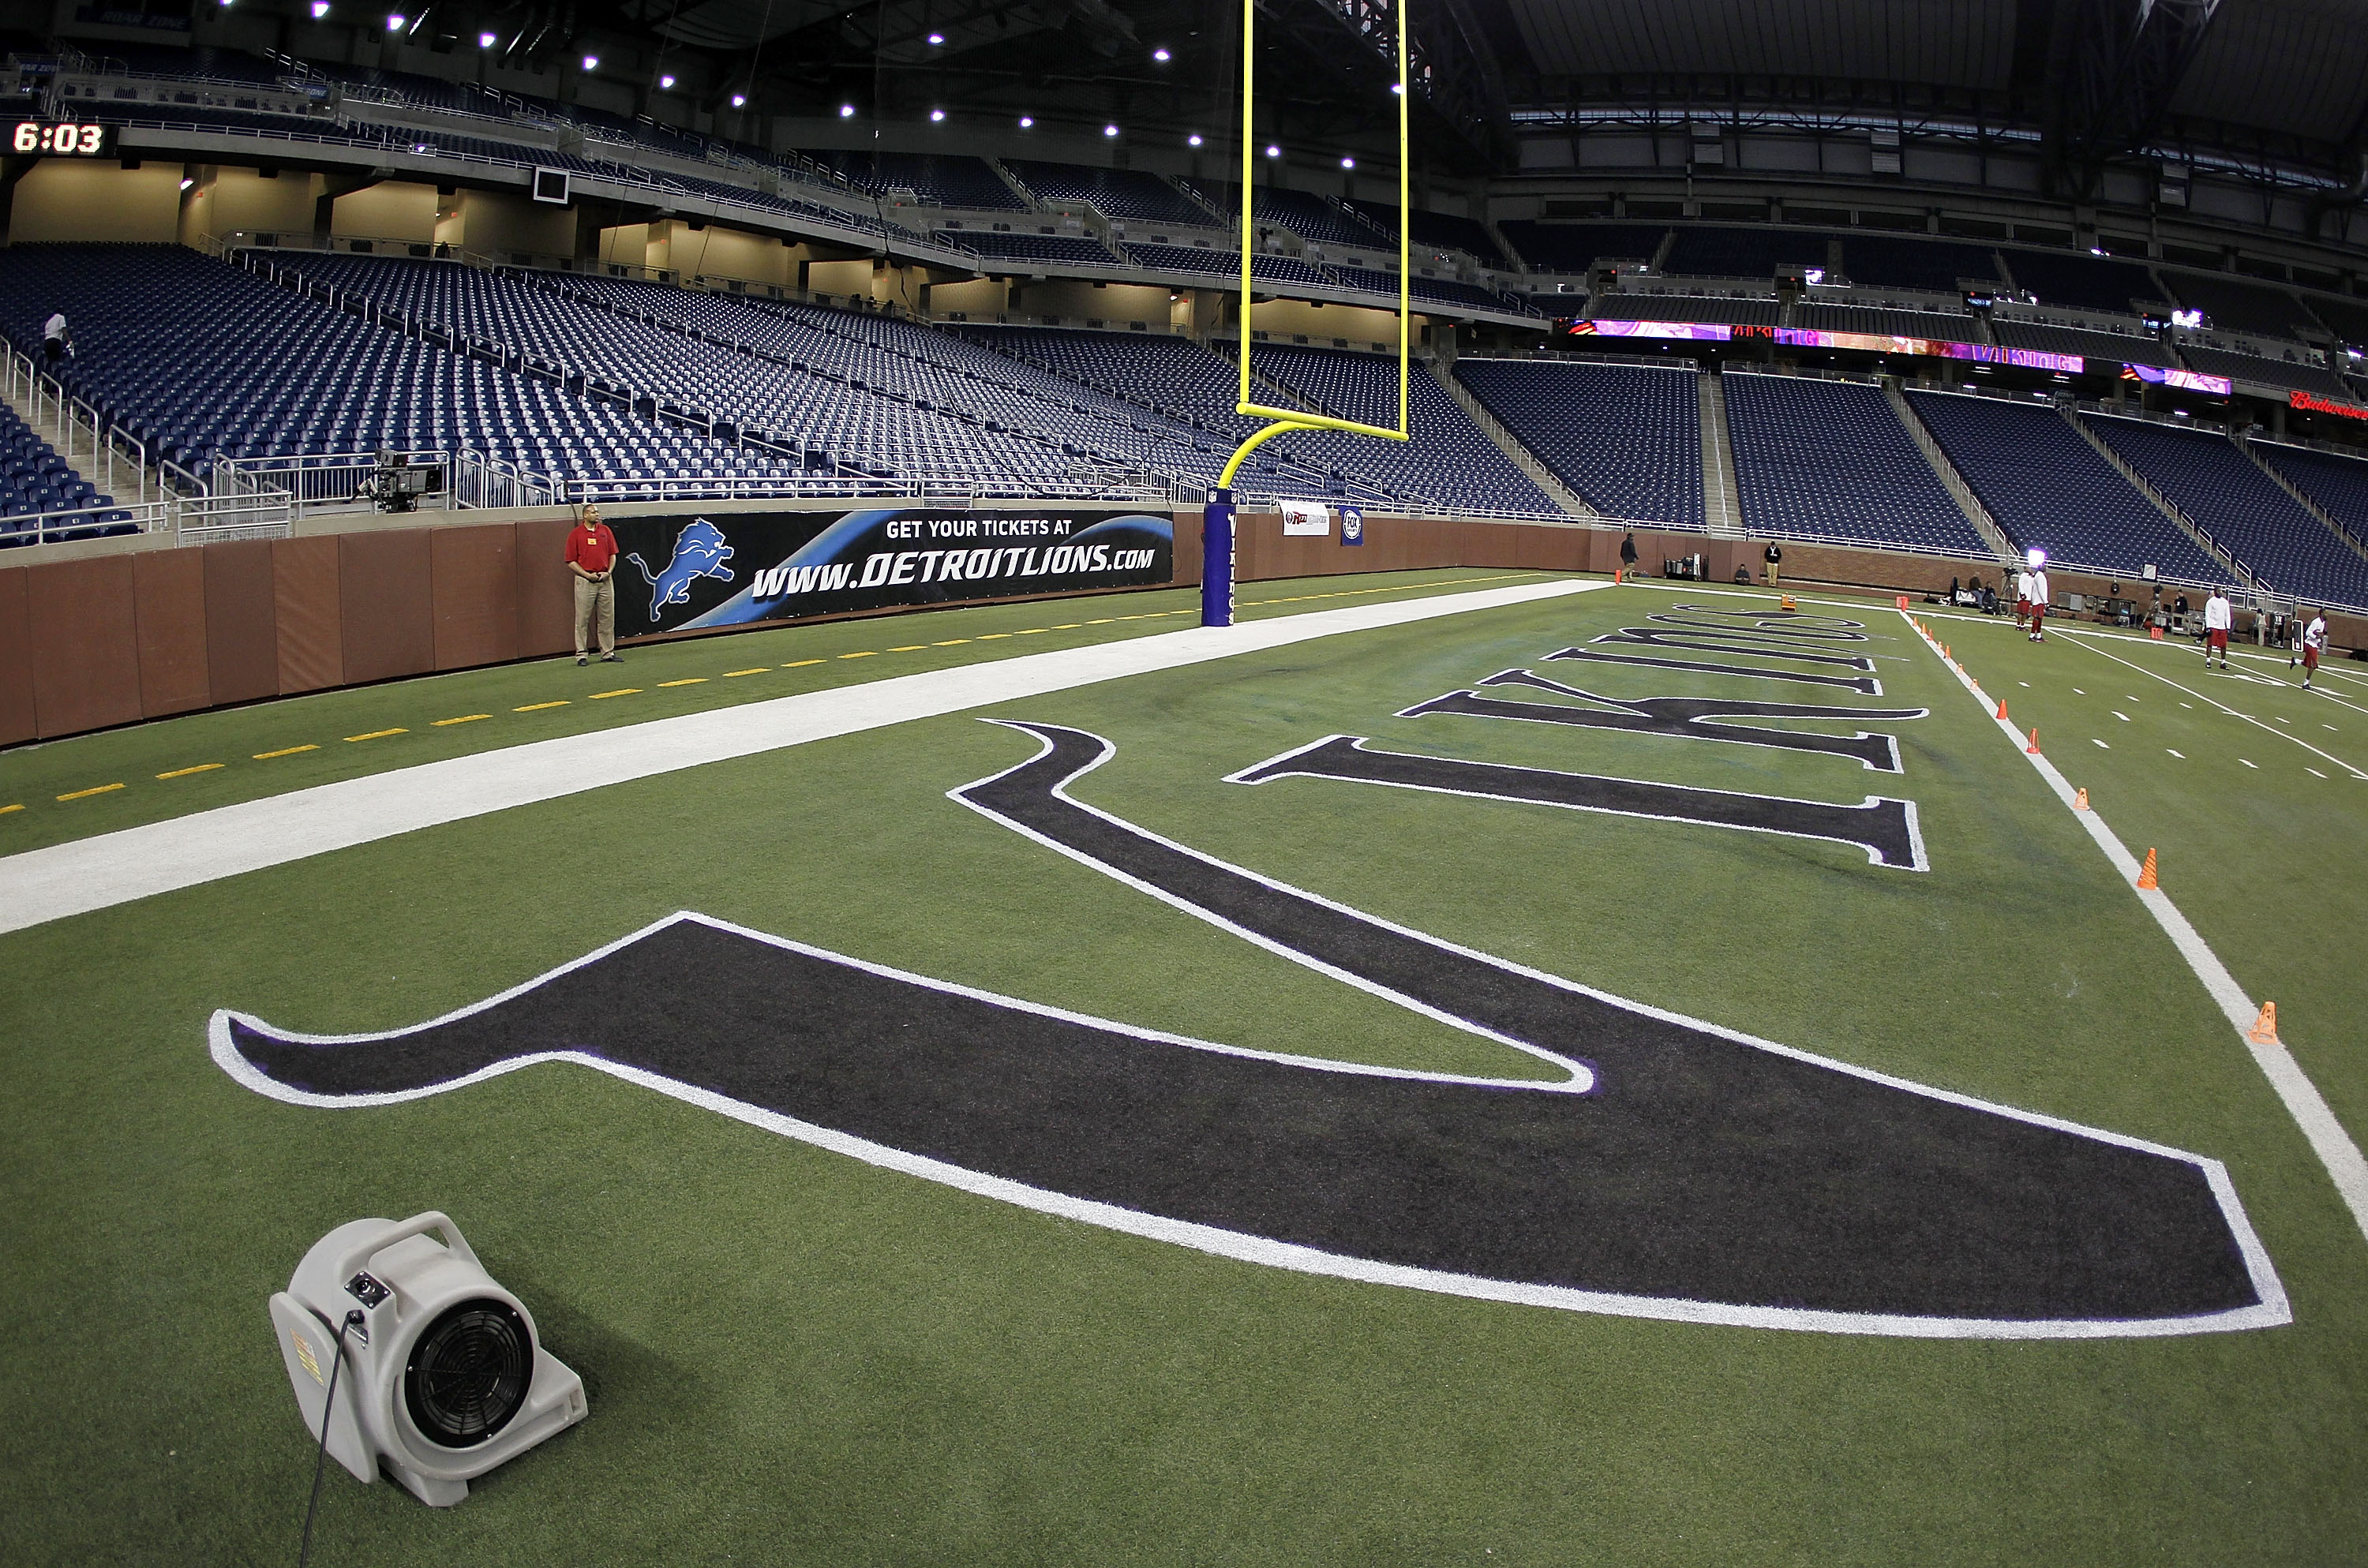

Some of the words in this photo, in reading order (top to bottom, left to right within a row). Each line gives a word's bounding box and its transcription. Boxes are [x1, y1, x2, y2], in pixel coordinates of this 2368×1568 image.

[13, 122, 103, 153] 6:03
[2290, 390, 2368, 419] Budweiser
[886, 520, 923, 538] GET
[927, 520, 977, 537] YOUR
[982, 519, 1049, 537] TICKETS
[1054, 519, 1072, 535] AT
[1347, 515, 1358, 529] FOX
